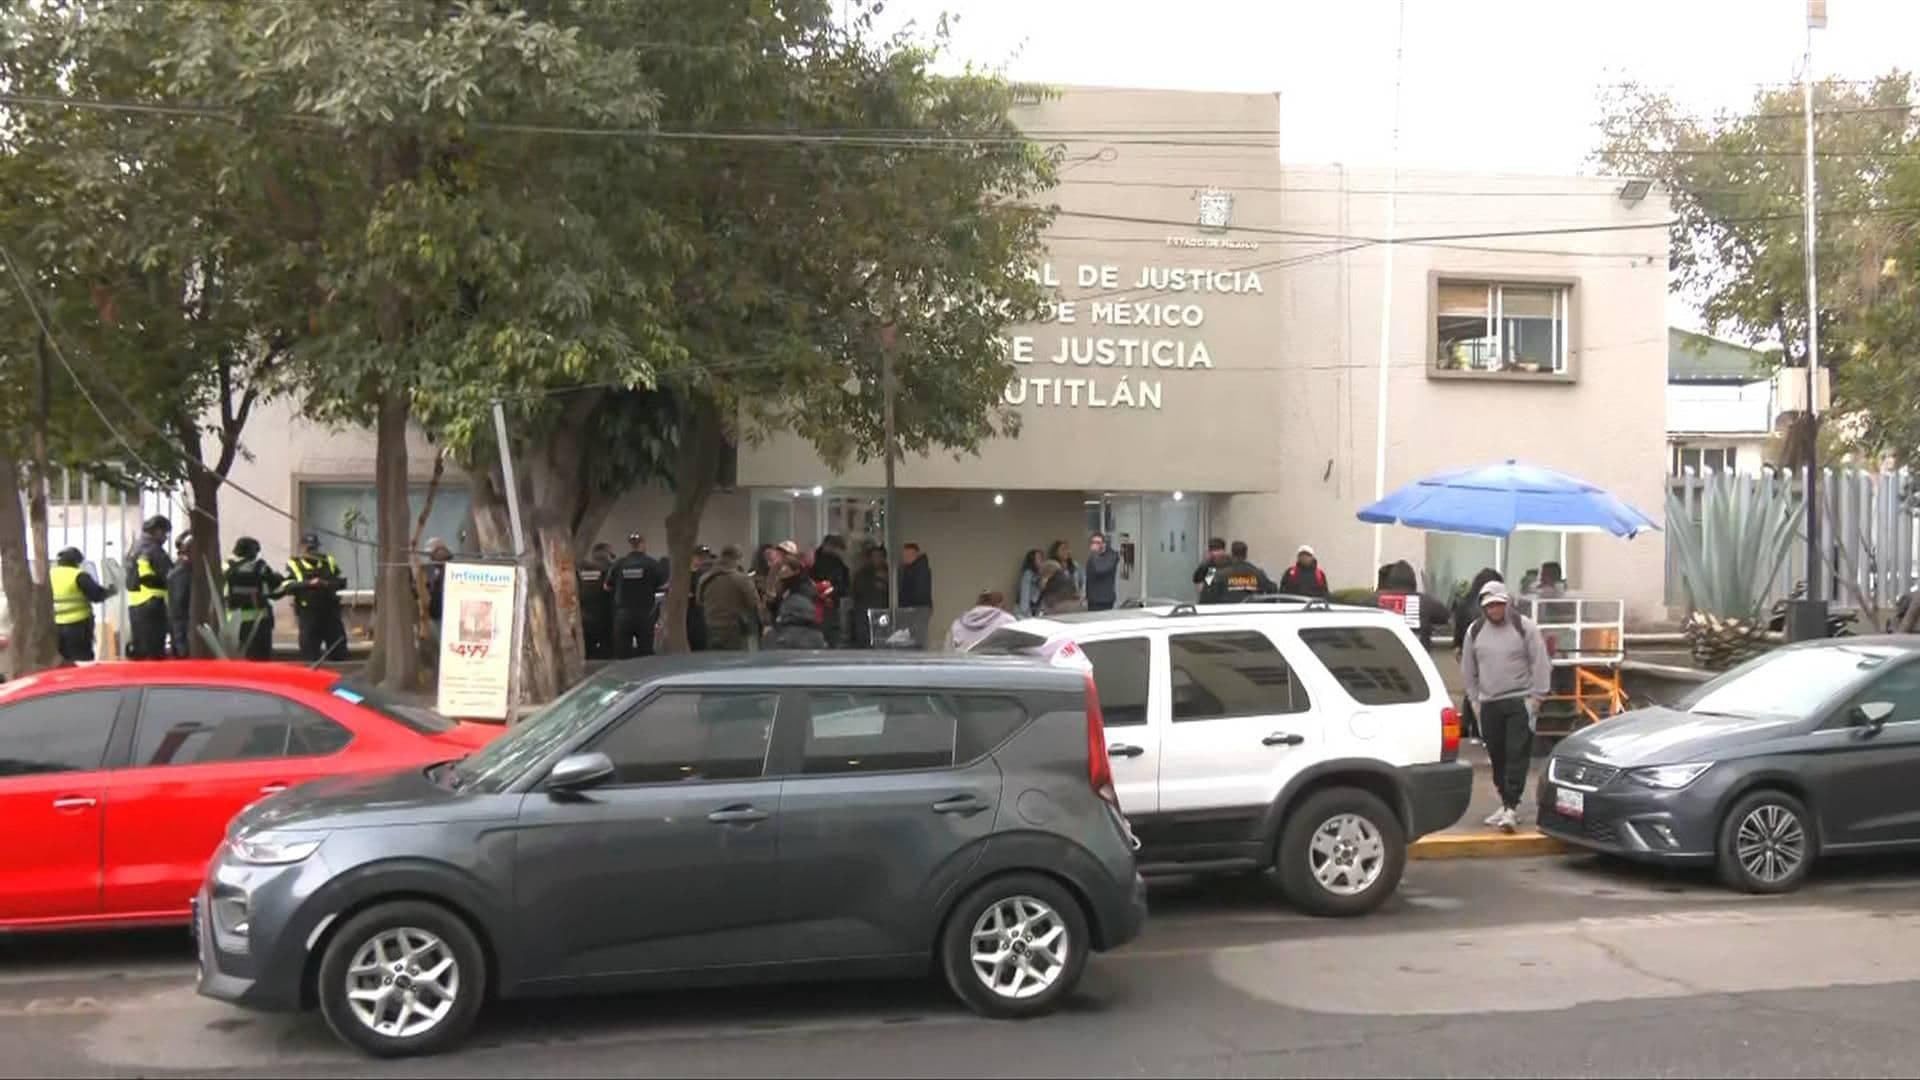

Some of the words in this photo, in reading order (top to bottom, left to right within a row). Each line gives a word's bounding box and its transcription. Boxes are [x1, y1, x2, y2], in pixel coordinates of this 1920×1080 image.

[1078, 264, 1120, 289] DE
[1134, 266, 1263, 294] JUSTICIA
[1091, 297, 1204, 327] MÉXICO
[1052, 336, 1213, 369] JUSTICIA
[998, 374, 1162, 409] UTITLÁN
